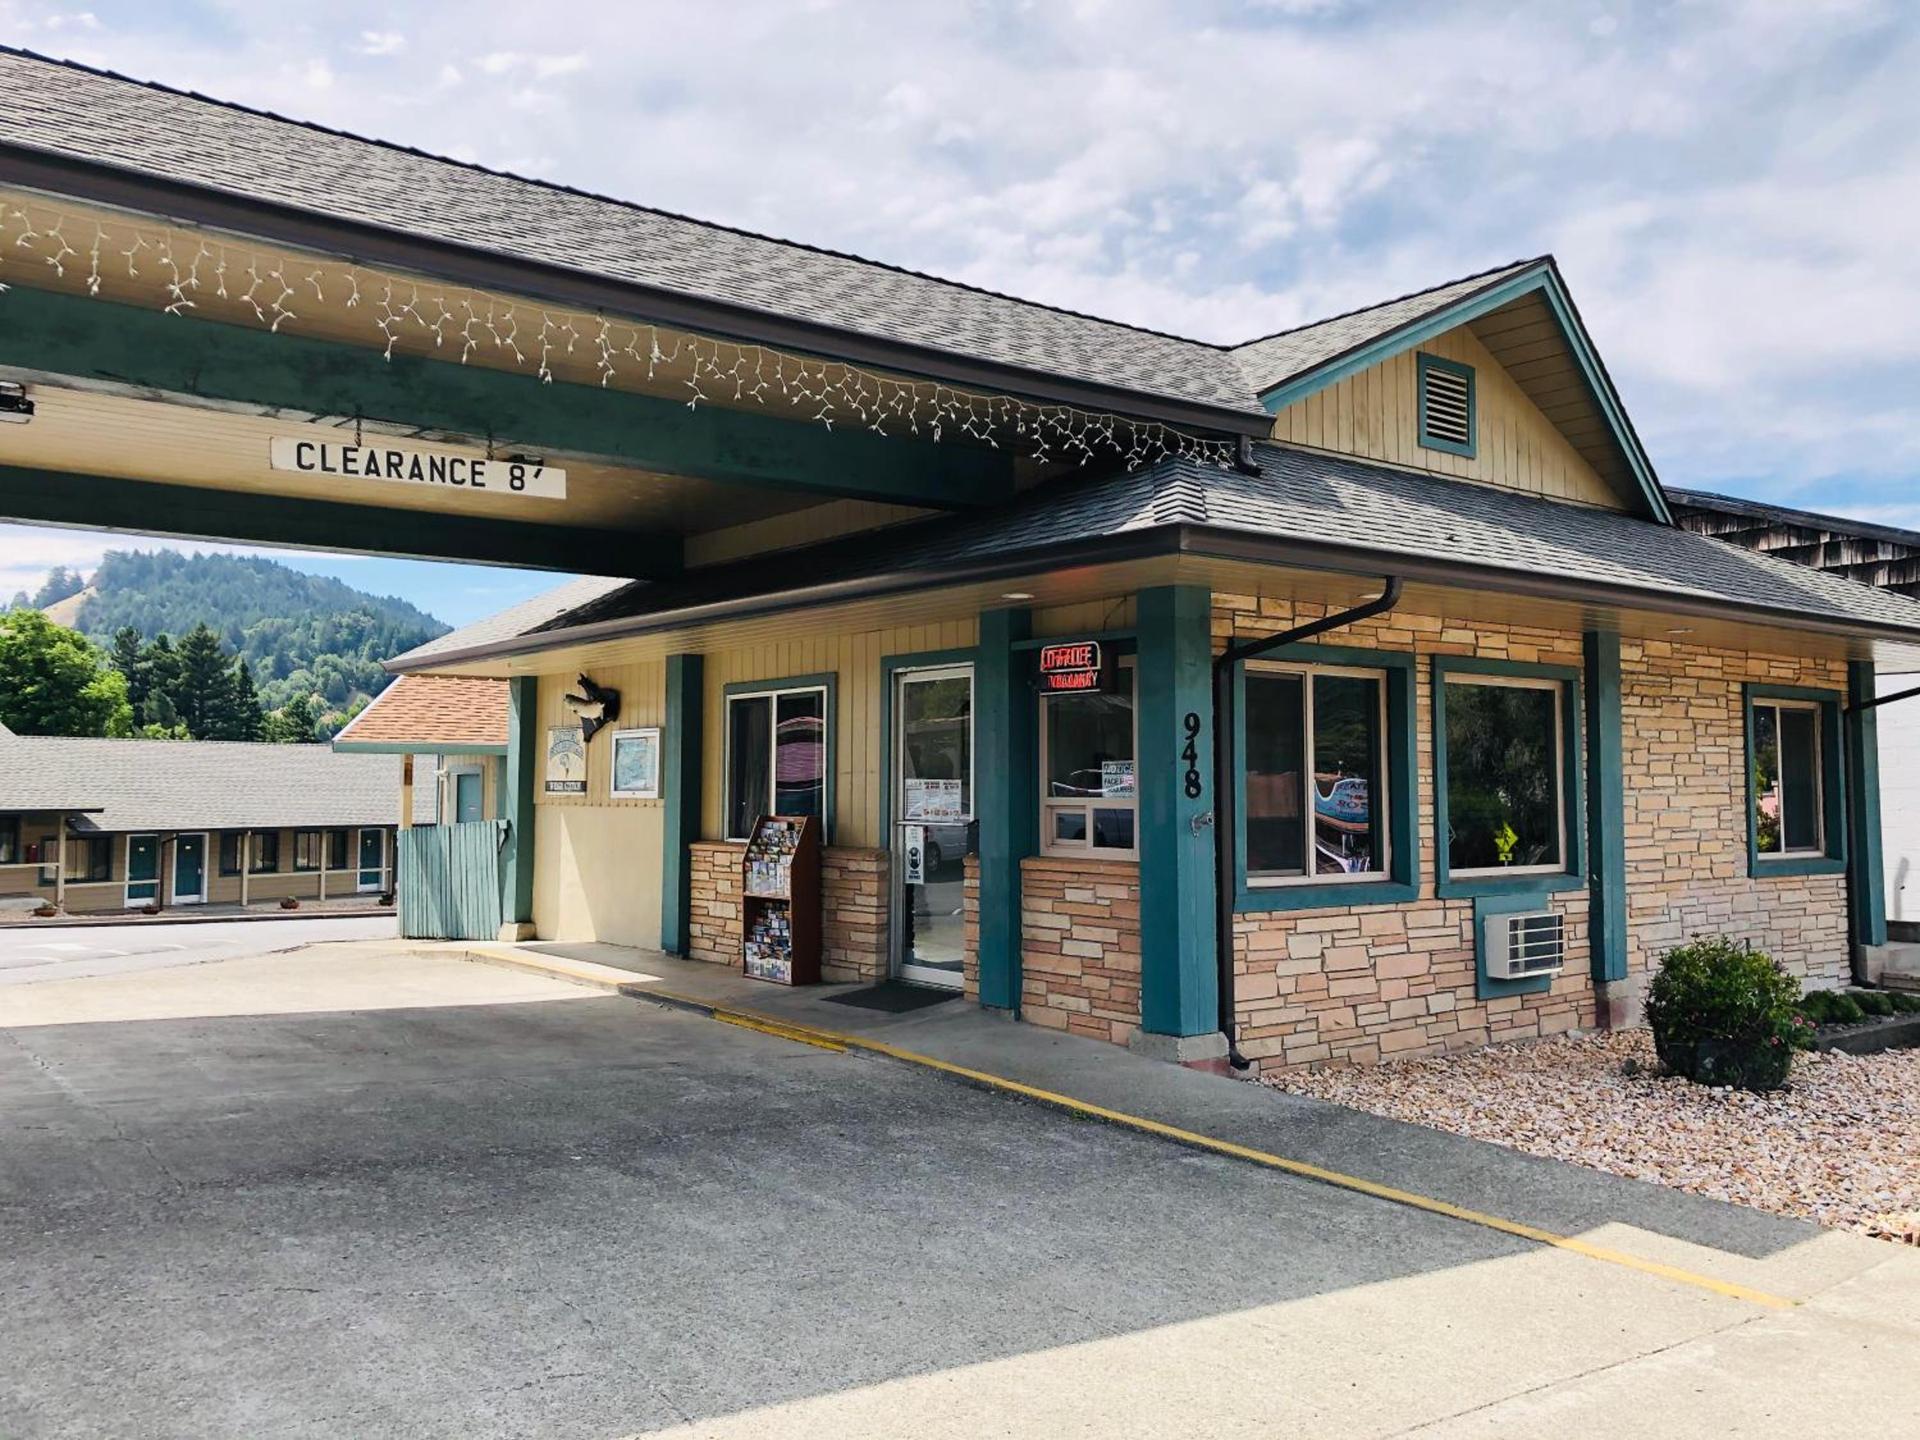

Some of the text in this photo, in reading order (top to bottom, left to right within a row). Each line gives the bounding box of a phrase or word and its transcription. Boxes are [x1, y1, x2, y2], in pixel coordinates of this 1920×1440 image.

[295, 442, 543, 491] CLEARANCE 8'
[1181, 712, 1201, 799] 948
